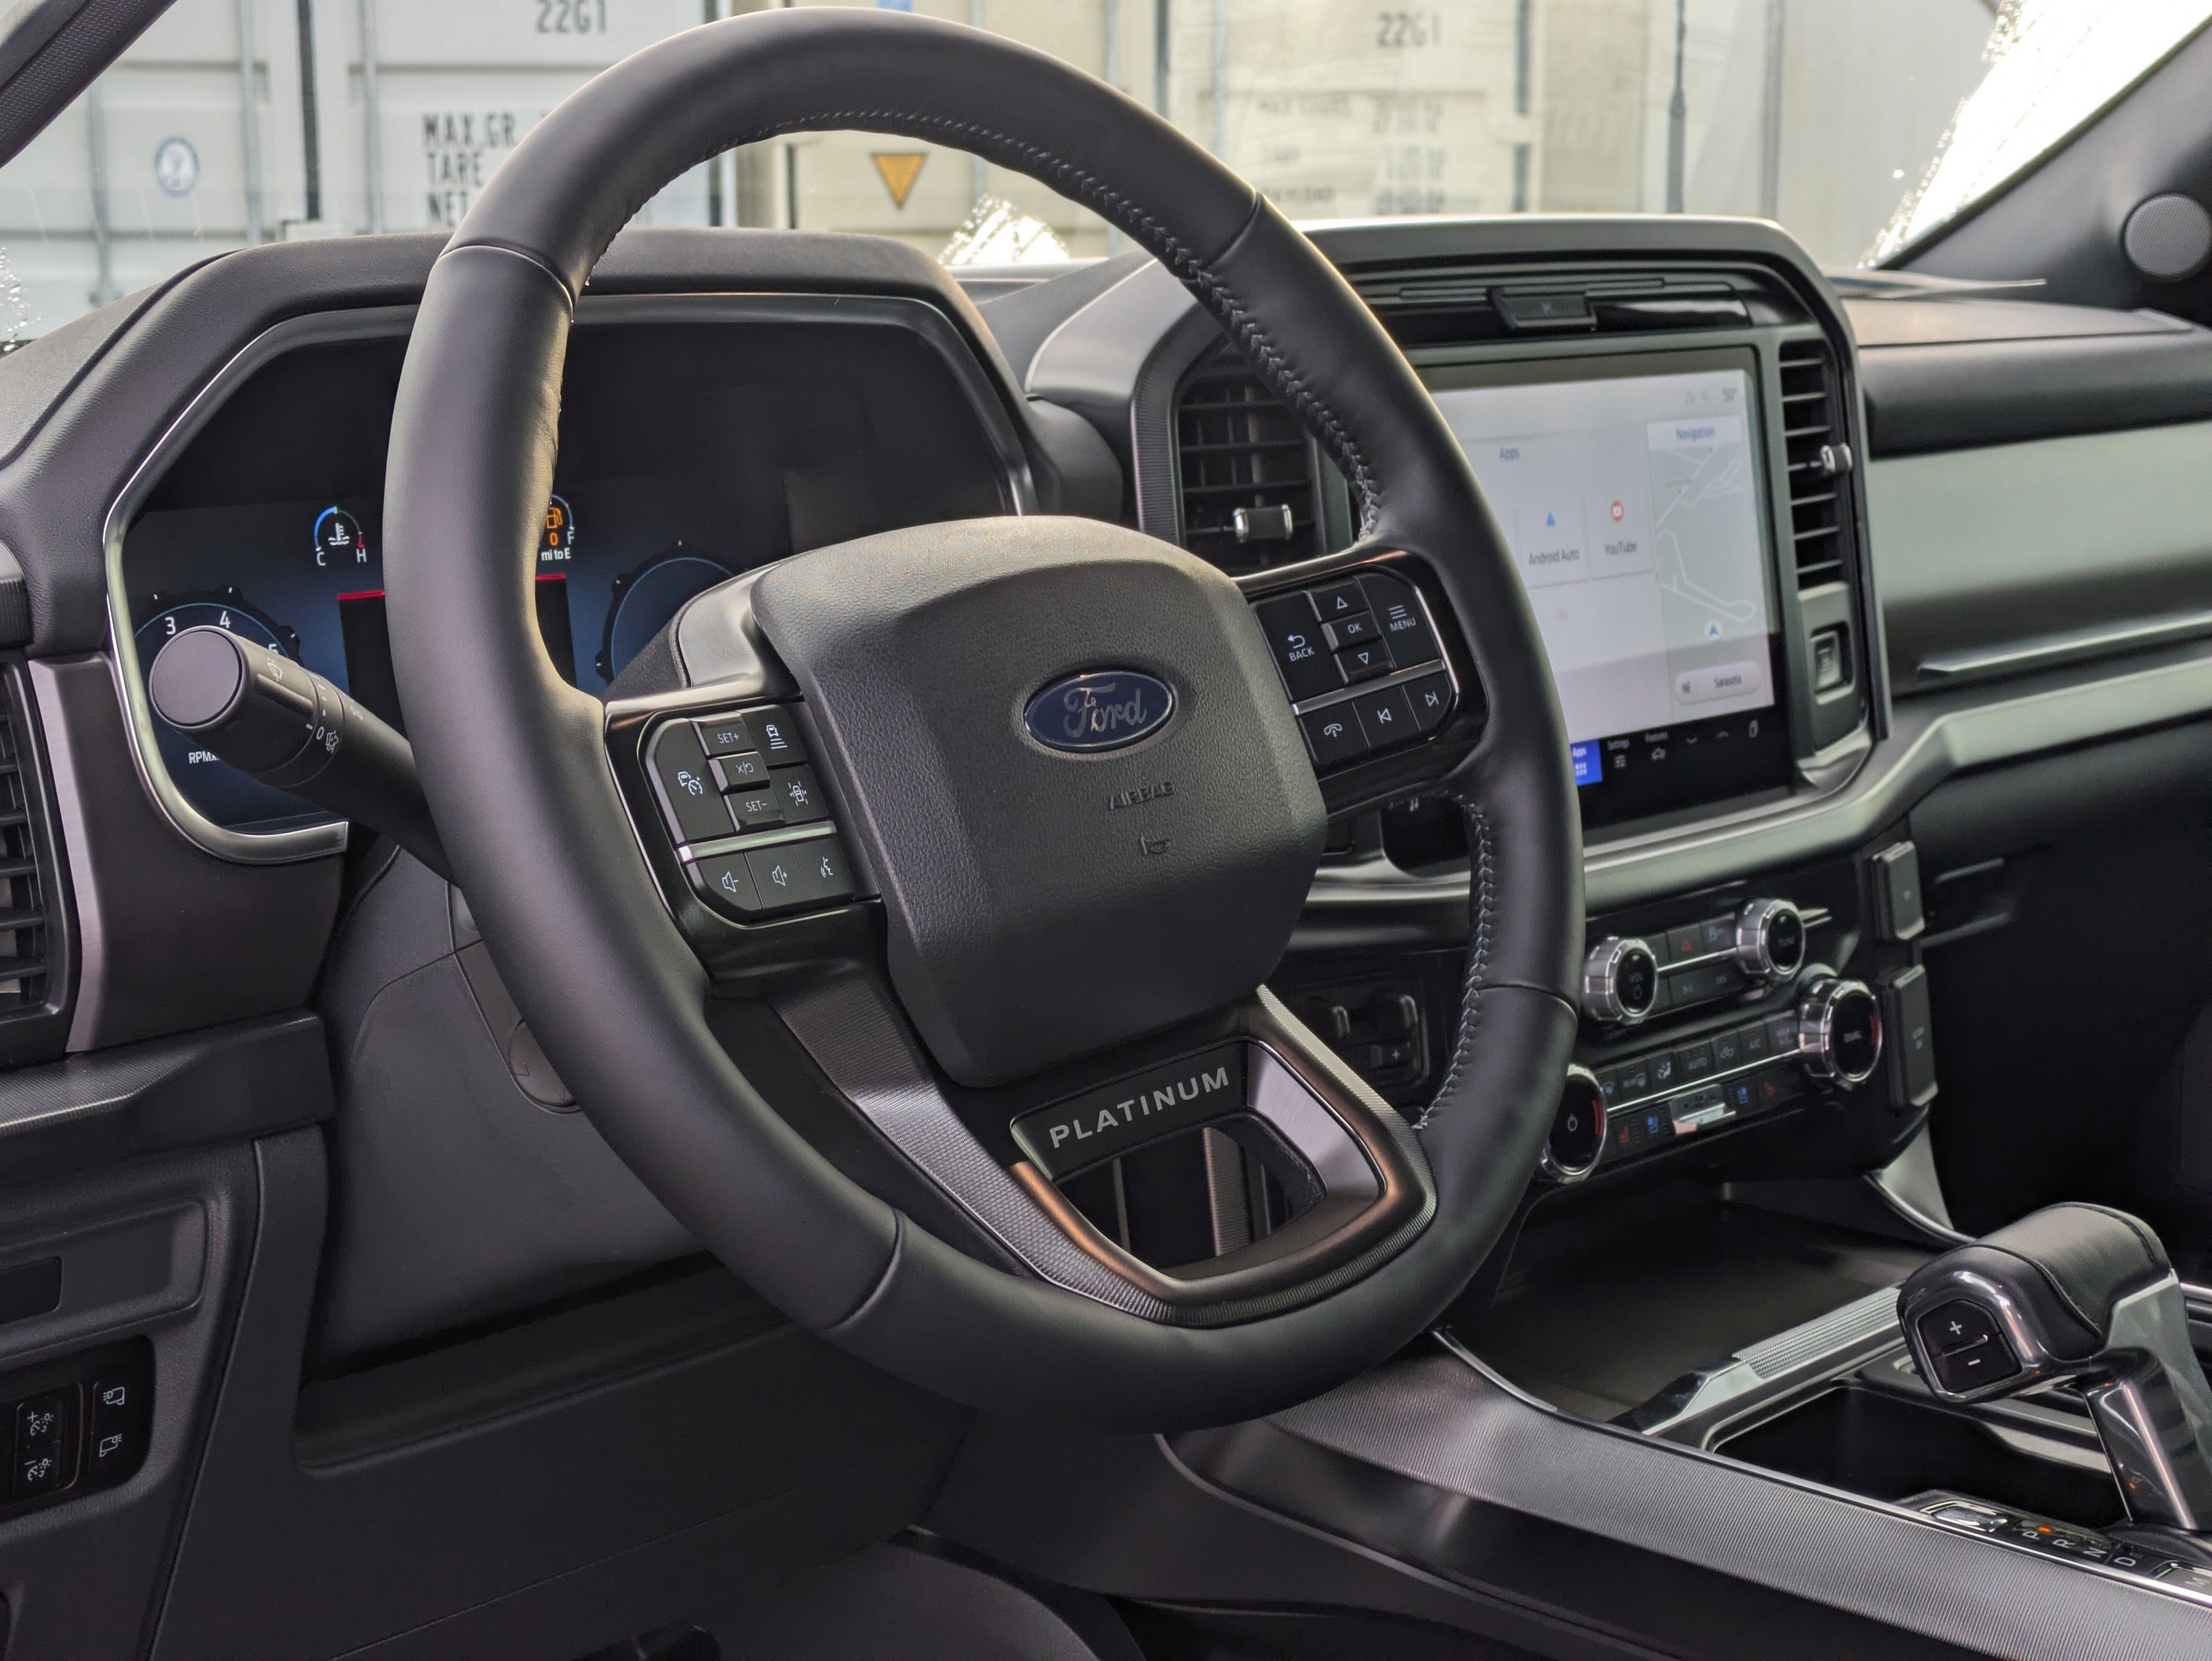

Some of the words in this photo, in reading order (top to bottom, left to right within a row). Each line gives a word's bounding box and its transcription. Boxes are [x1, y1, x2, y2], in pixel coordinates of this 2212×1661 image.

[536, 0, 606, 33] 22G1
[427, 152, 484, 187] TARE
[1676, 427, 1715, 442] Navigation
[1499, 447, 1520, 461] Apps
[356, 548, 367, 563] H
[541, 549, 553, 561] mi
[553, 549, 564, 560] to
[564, 547, 571, 559] E
[1604, 541, 1637, 556] YouTube
[316, 552, 326, 566] C
[1529, 551, 1560, 565] Android
[1561, 549, 1580, 561] Auto
[165, 617, 176, 635] 3
[220, 610, 231, 628] 4
[1390, 618, 1416, 631] MENU
[1348, 623, 1362, 633] OK
[1289, 646, 1315, 661] BACK
[1063, 682, 1147, 738] Ford
[1109, 781, 1175, 809] AIRBAG
[1049, 1066, 1229, 1148] PLATINUM
[2022, 1530, 2040, 1540] P
[2052, 1539, 2076, 1549] R
[2114, 1557, 2136, 1567] D
